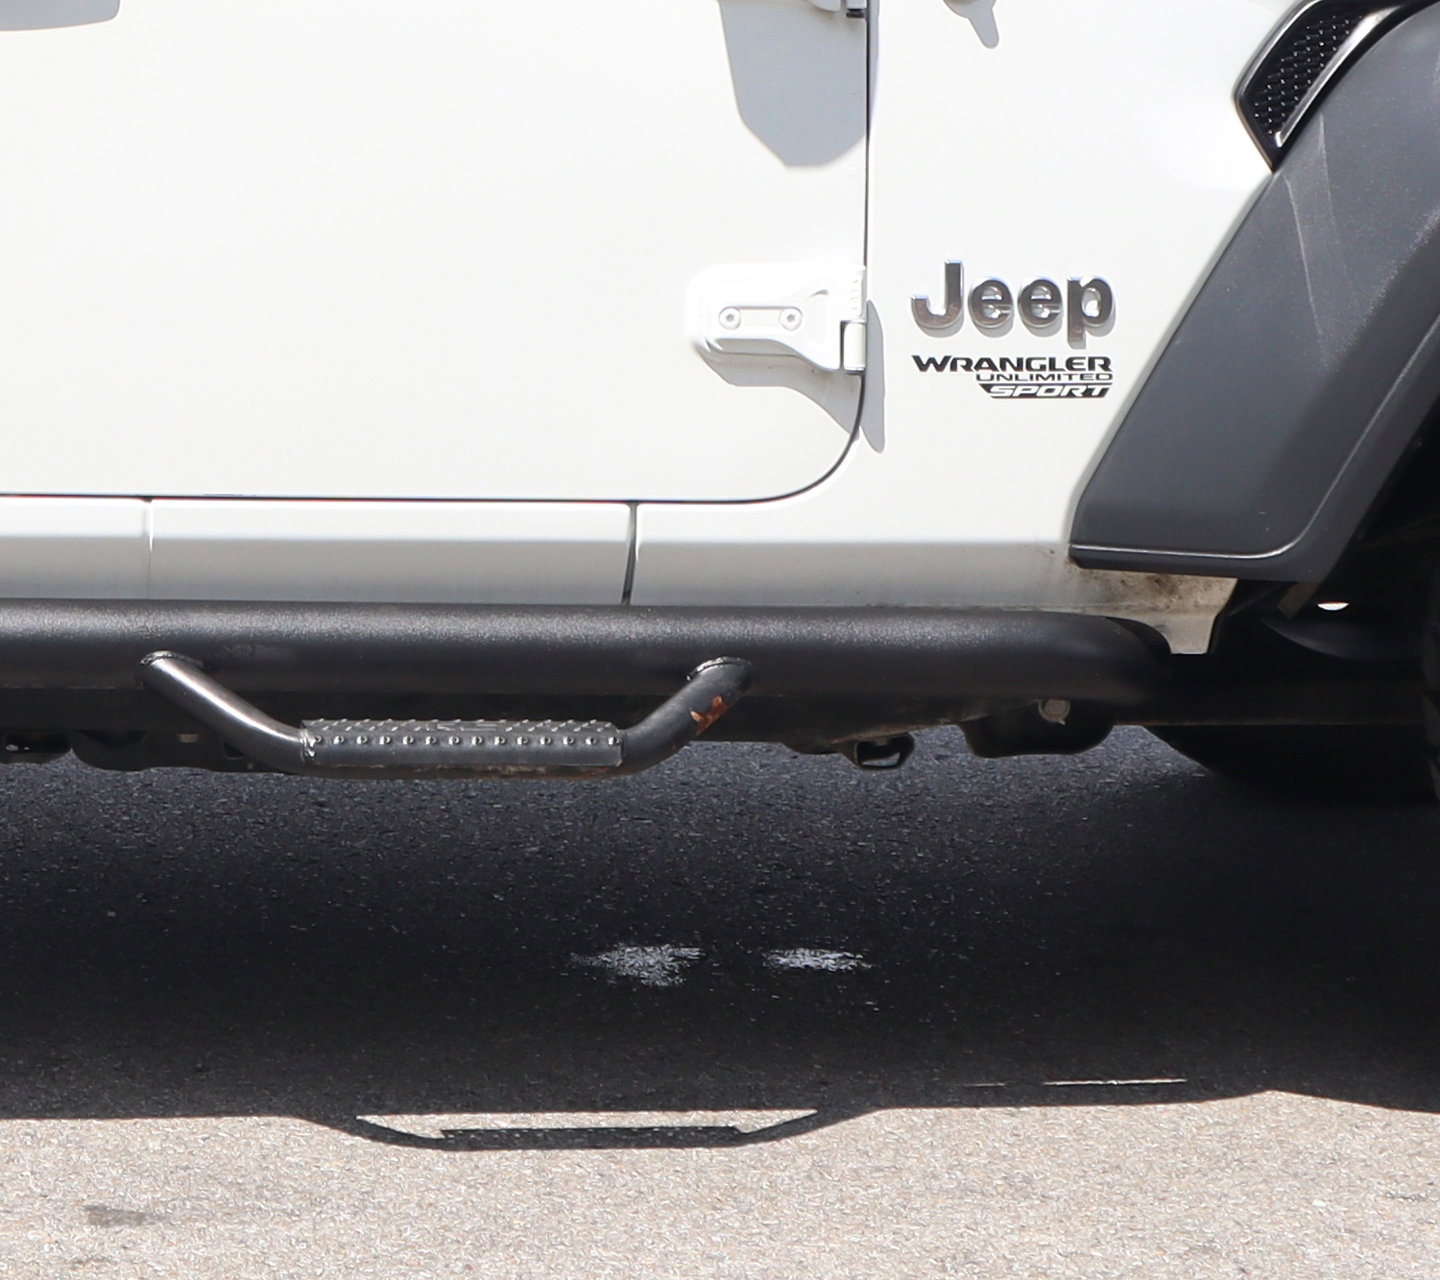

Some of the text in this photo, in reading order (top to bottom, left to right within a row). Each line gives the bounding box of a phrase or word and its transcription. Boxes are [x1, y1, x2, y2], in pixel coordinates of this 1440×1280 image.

[911, 259, 1115, 349] Jeep
[911, 354, 1113, 372] WRANGLER
[976, 373, 1113, 381] UNLIMITED
[989, 385, 1110, 397] SPORT
